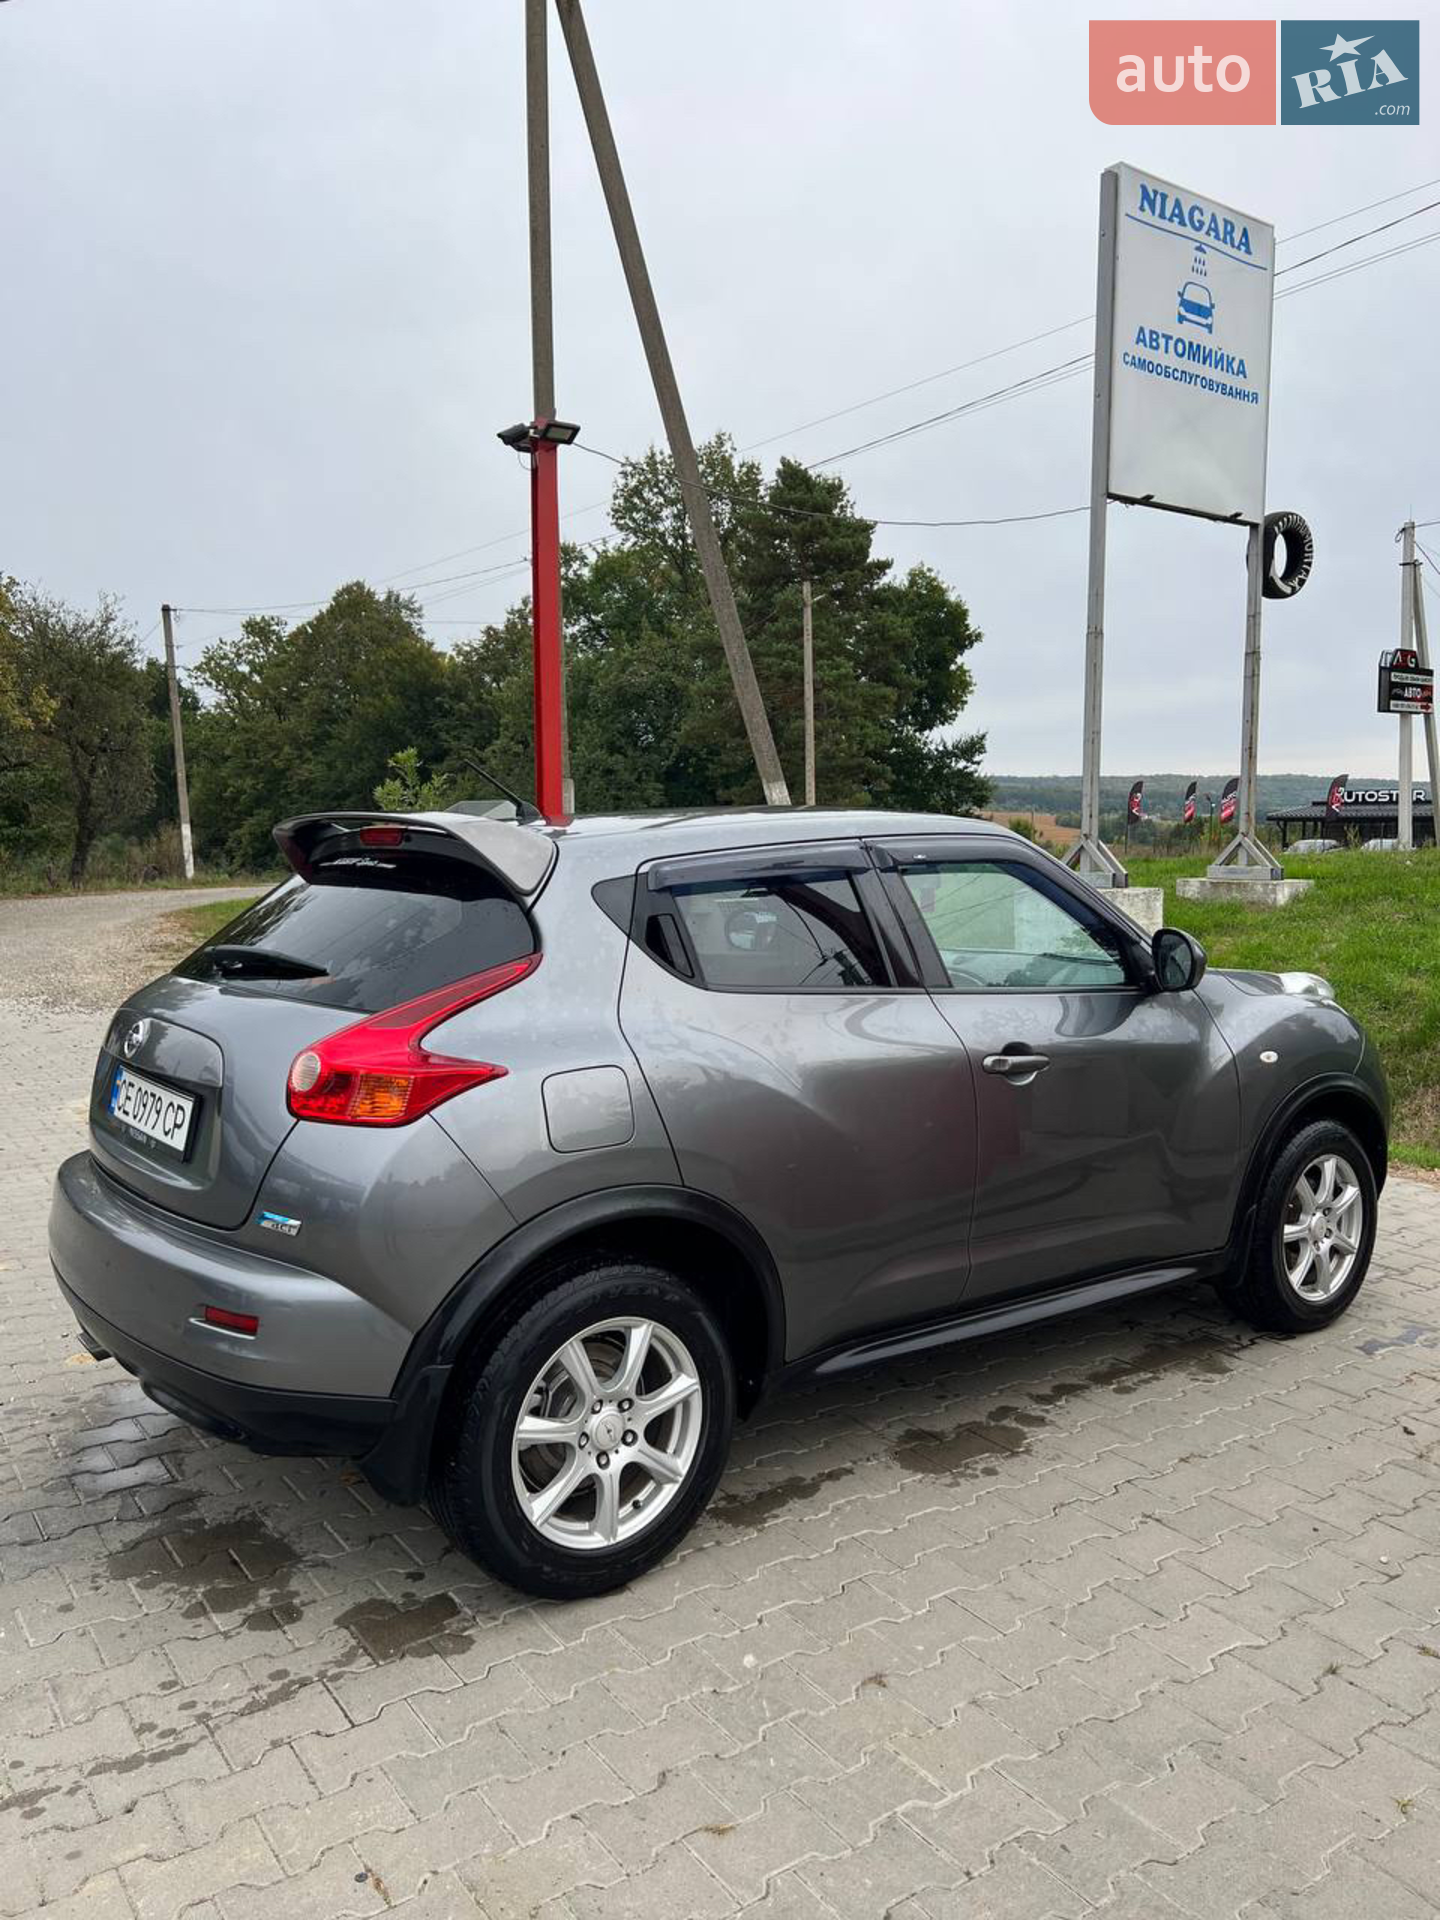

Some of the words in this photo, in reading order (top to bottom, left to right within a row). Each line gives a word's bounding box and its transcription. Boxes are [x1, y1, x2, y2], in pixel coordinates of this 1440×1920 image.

[1139, 183, 1253, 256] NIAGARA
[1122, 351, 1259, 405] САМООБСЛУГОВУВАННЯ
[1135, 326, 1248, 379] АВТОМИЙКА
[1342, 789, 1426, 803] UTOSTR
[132, 1087, 163, 1130] 0979
